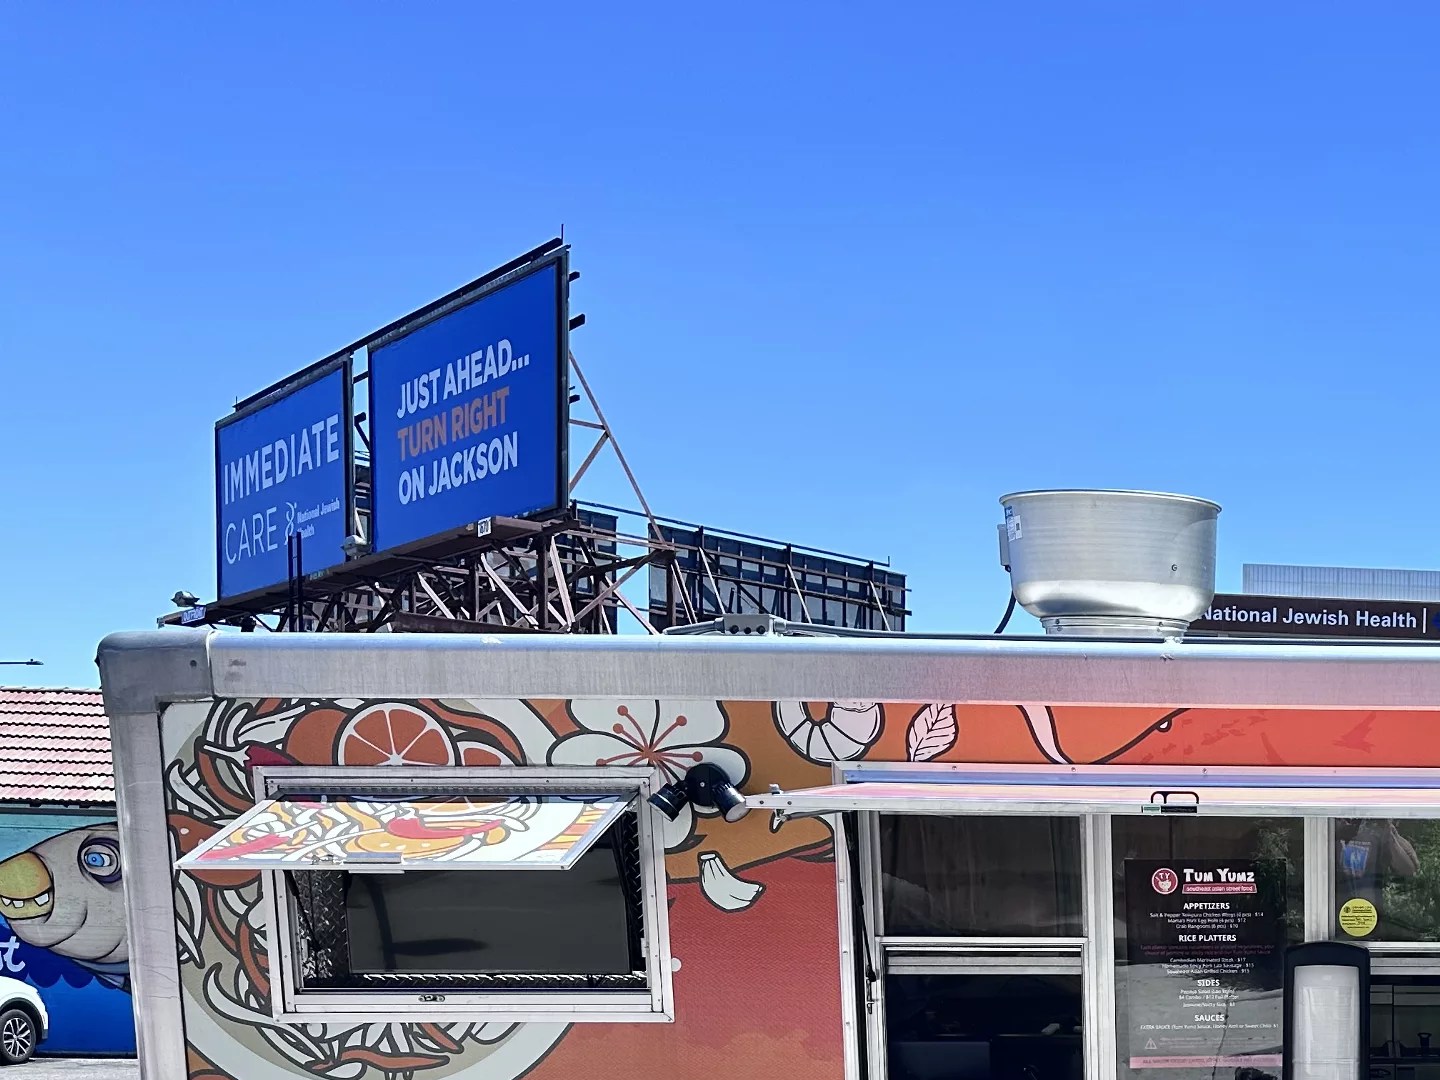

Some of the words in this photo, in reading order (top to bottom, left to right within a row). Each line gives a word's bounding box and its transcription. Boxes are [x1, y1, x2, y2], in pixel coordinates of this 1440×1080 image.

[397, 368, 440, 419] JUST
[443, 339, 530, 400] AHEAD...
[397, 412, 447, 462] TURN
[452, 386, 510, 442] RIGHT
[225, 413, 339, 505] IMMEDIATE
[399, 465, 425, 505] ON
[428, 431, 518, 495] JACKSON
[225, 507, 278, 565] CARE
[1282, 607, 1349, 627] Jewish
[1356, 610, 1417, 628] Health
[1183, 902, 1230, 910] APPETIZERS
[1194, 1014, 1224, 1022] SAUCES
